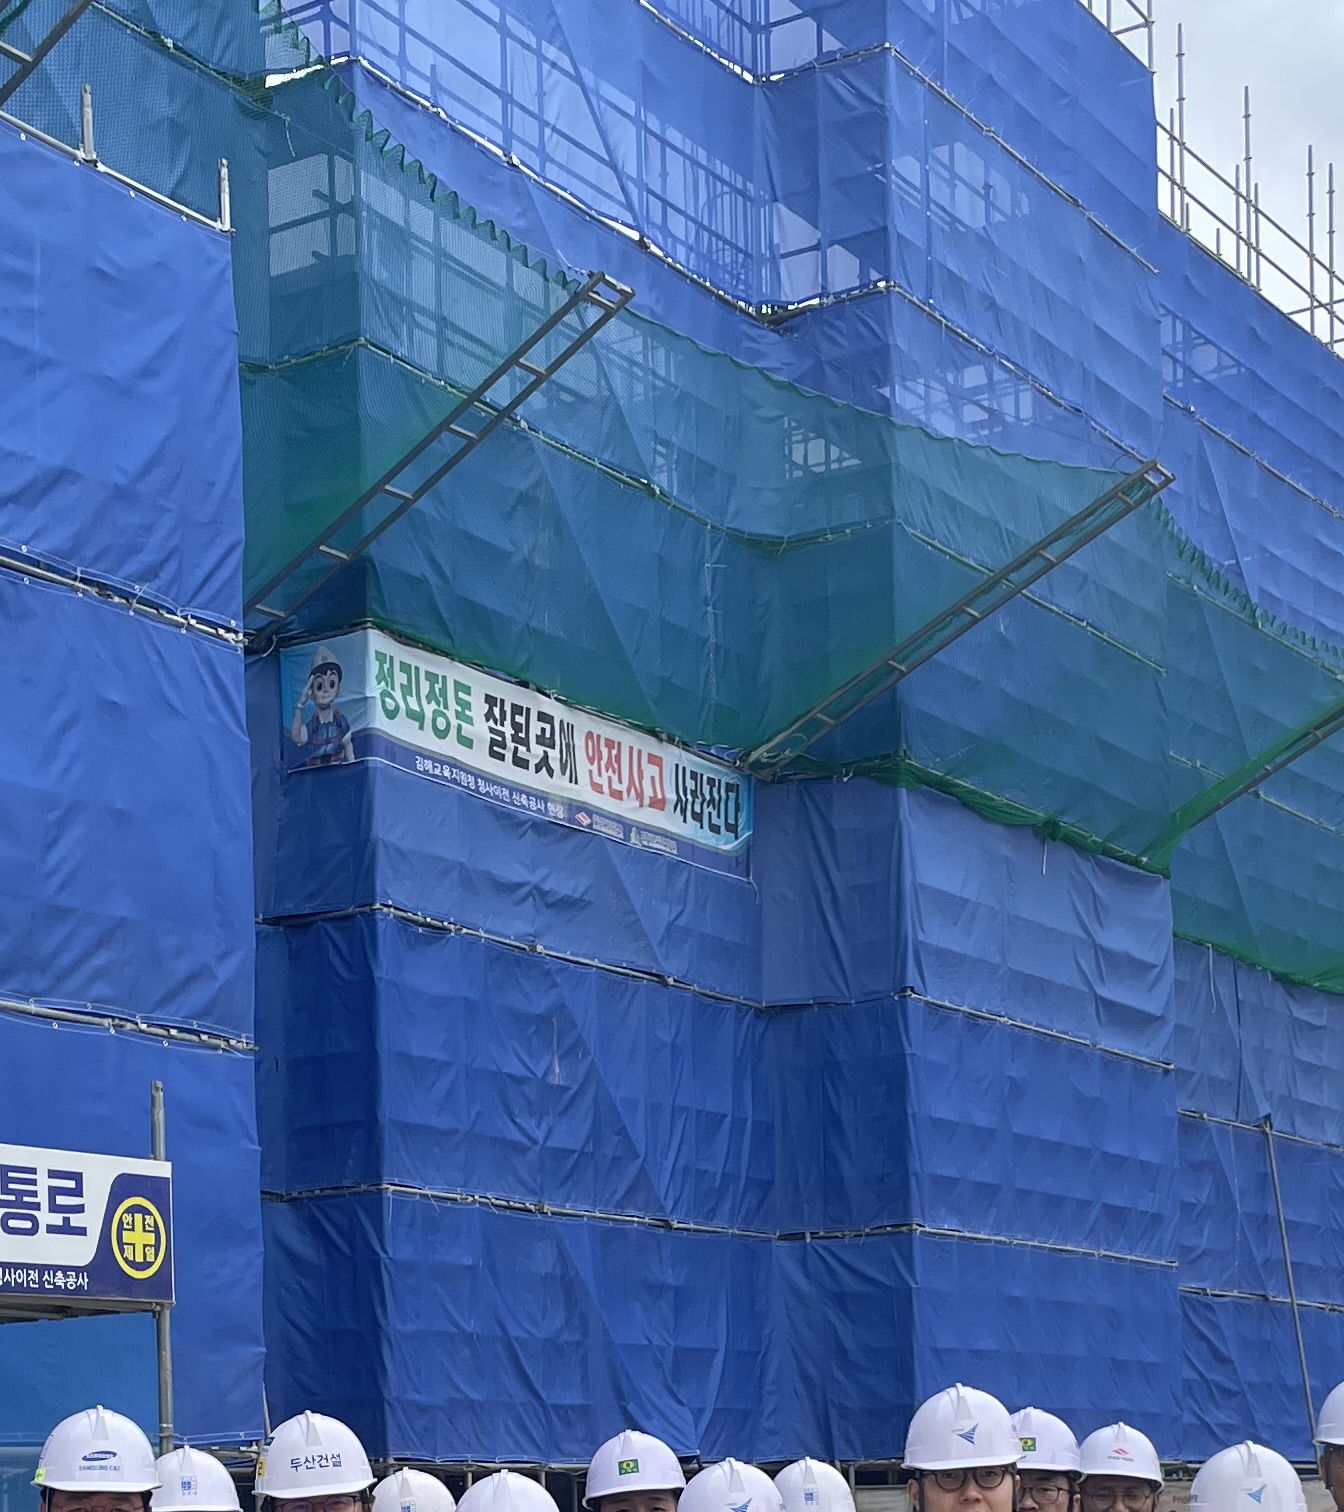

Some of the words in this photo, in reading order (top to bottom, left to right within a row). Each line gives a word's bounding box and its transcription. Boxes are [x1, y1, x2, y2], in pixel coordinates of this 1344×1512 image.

[373, 648, 474, 750] 정리정돈
[483, 691, 578, 786] 잘된곳에
[584, 729, 666, 812] 안전사고
[673, 762, 741, 841] 사라진다
[415, 755, 476, 790] 김해교육지원청
[42, 1270, 89, 1291] 신축공사
[290, 1453, 343, 1473] 두산건설
